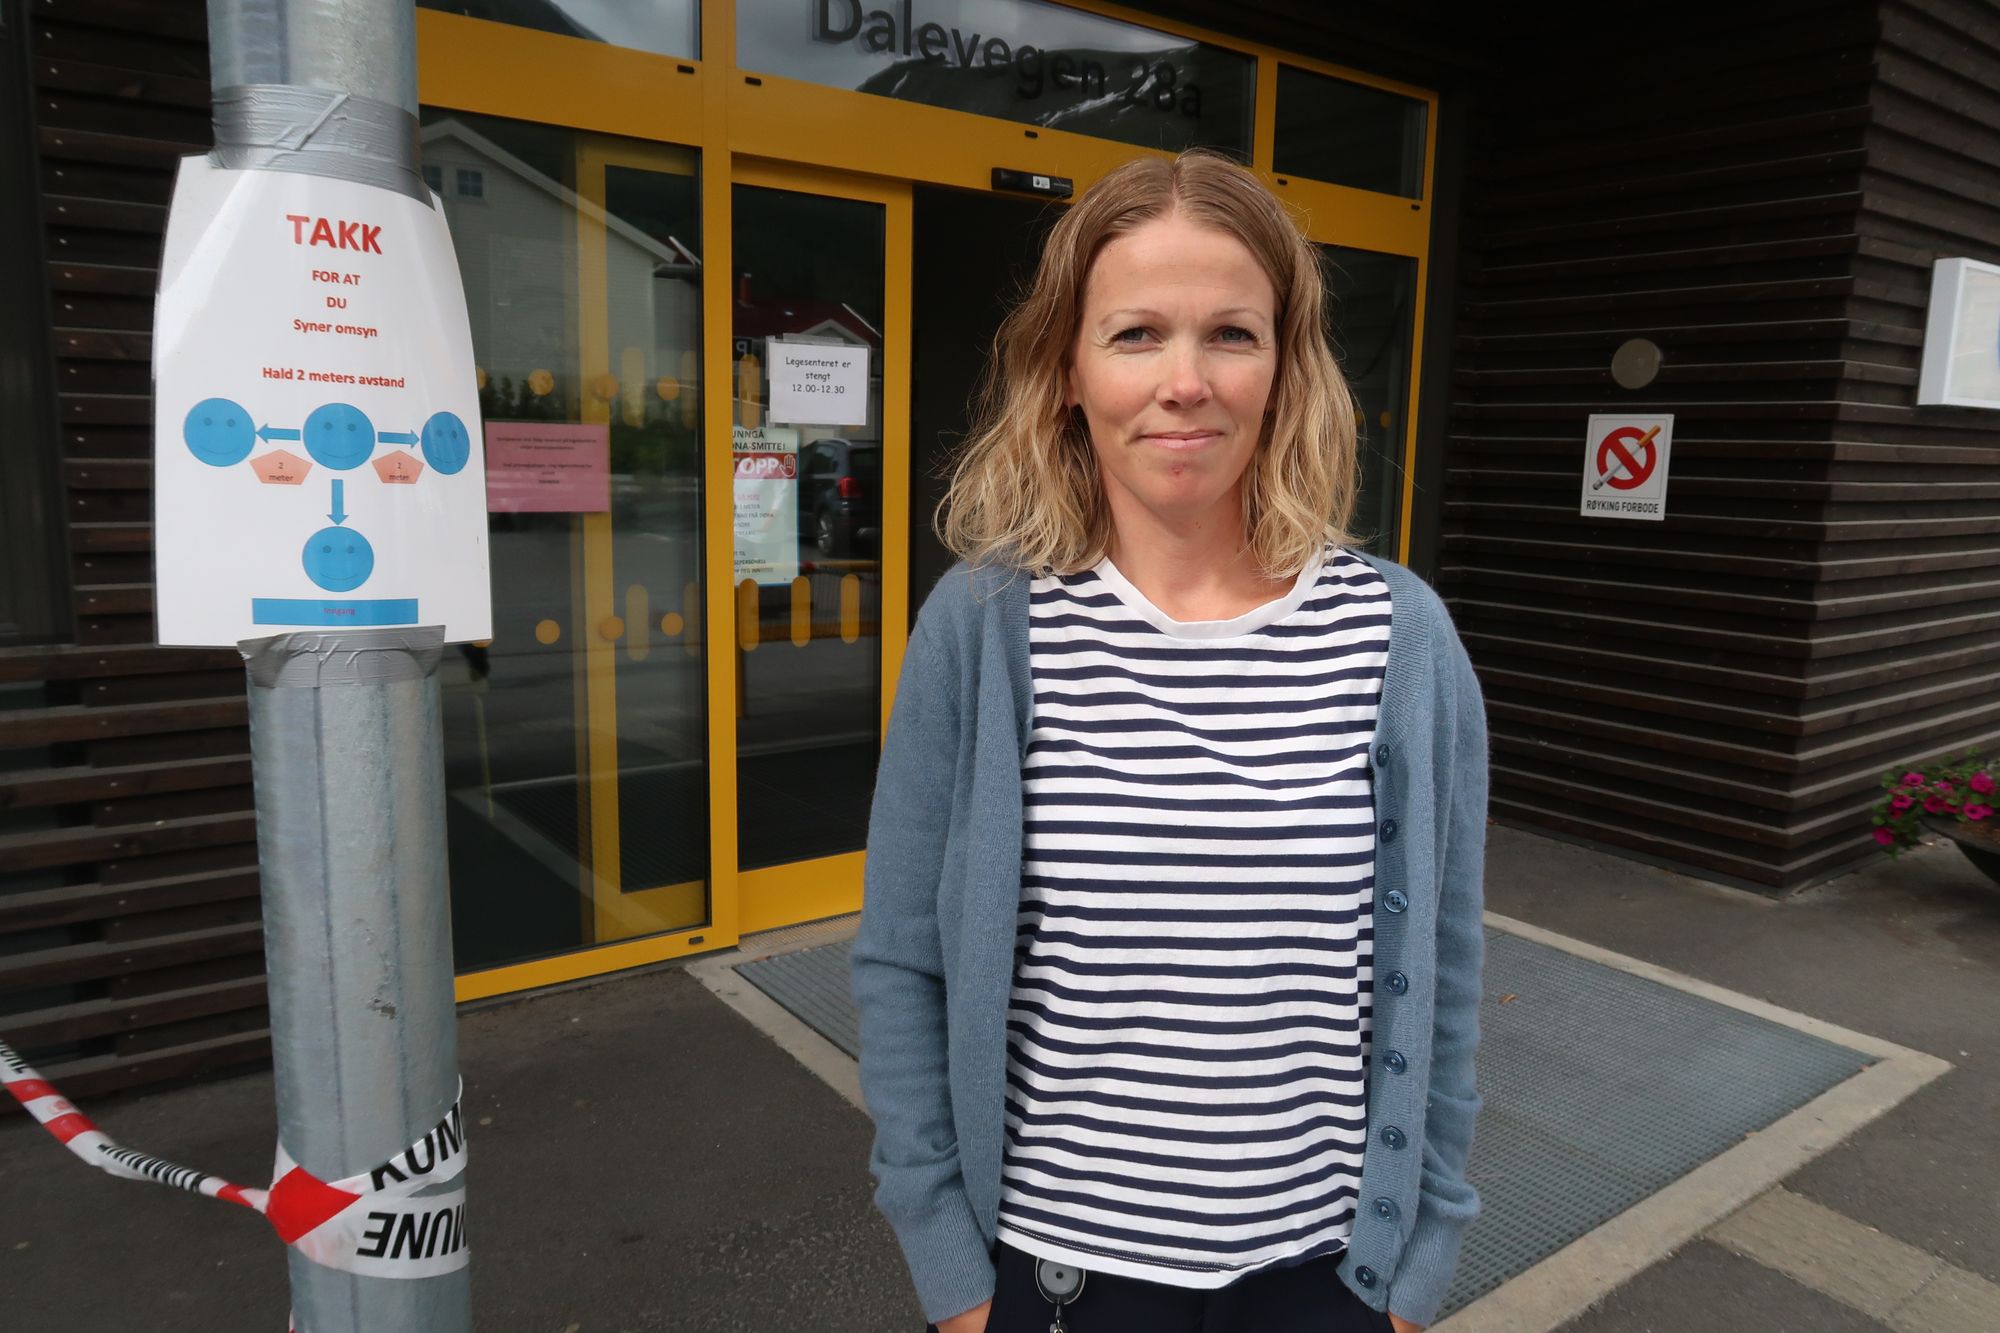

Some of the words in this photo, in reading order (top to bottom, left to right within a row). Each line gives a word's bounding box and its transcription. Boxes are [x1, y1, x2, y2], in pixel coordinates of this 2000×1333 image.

[817, 0, 1105, 98] Dalevegen
[1126, 55, 1200, 118] 28a
[286, 214, 383, 255] TAKK
[312, 270, 340, 283] FOR
[342, 273, 361, 285] AT
[326, 296, 347, 309] DU
[293, 319, 332, 333] Syner
[335, 325, 378, 338] omsyn
[786, 356, 839, 368] Legesenteret
[262, 367, 293, 380] Hald
[297, 370, 305, 380] 2
[309, 371, 355, 384] meters
[359, 376, 405, 388] avstand
[805, 372, 831, 382] stengt
[792, 383, 845, 394] 12.00-12.30
[733, 442, 786, 450] NA-SMITTE!
[269, 474, 294, 482] meter
[1586, 500, 1620, 511] RØYKING
[1621, 502, 1659, 513] FORBODE
